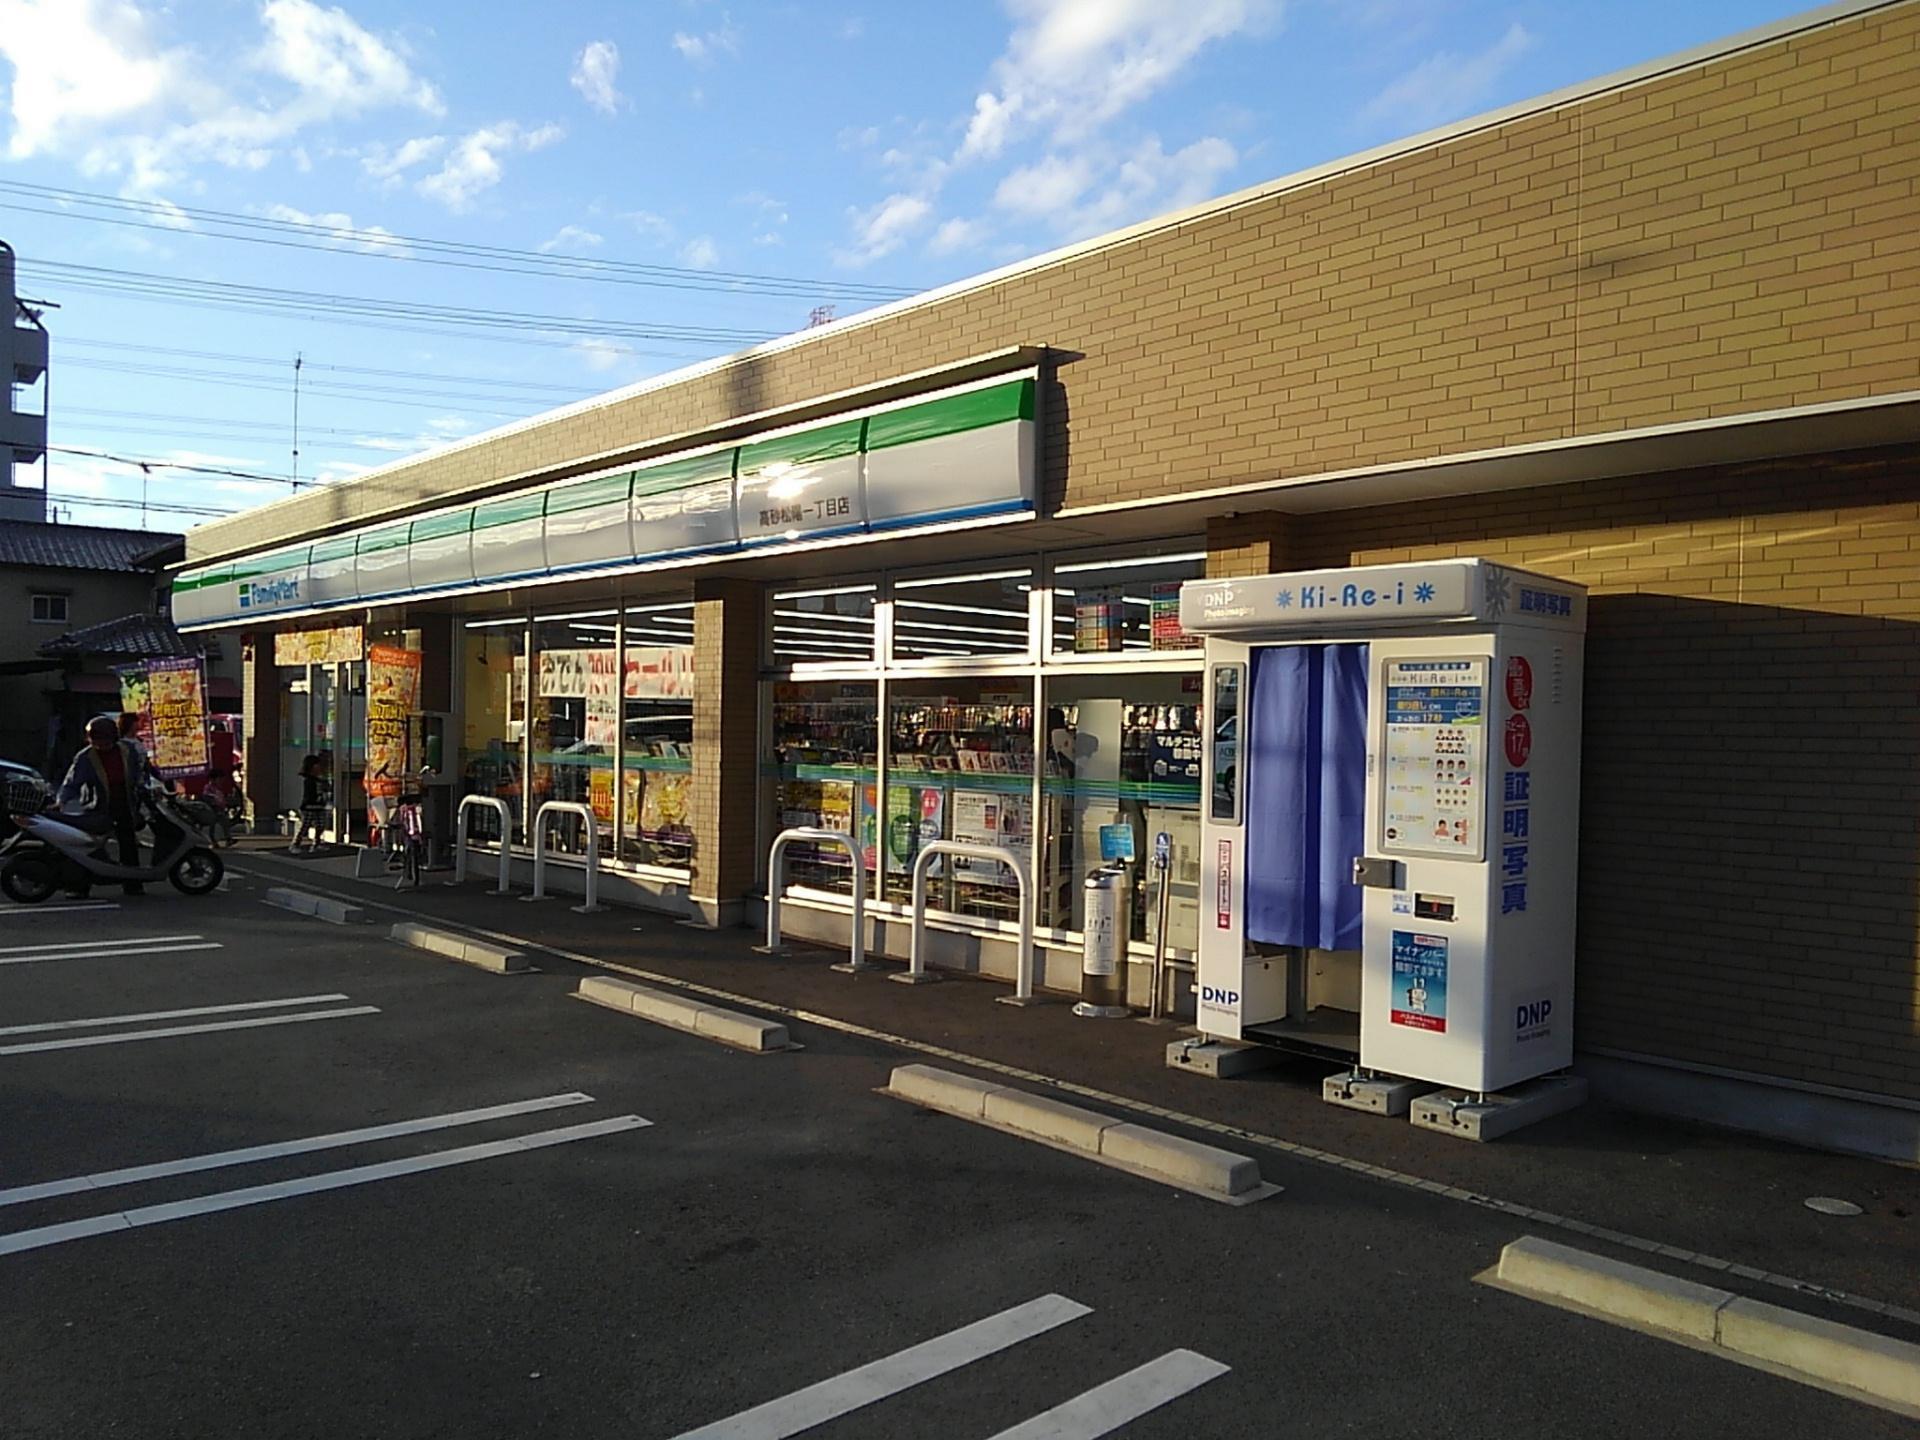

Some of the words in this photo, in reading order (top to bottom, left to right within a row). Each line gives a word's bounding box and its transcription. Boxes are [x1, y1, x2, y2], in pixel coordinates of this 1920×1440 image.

[1205, 590, 1234, 607] DNP
[1301, 582, 1404, 608] Ki-Re-i
[1520, 588, 1572, 616] 証明写真
[1502, 772, 1530, 915] 証明写真
[1202, 986, 1239, 1005] DNP
[1517, 999, 1551, 1029] DNP
